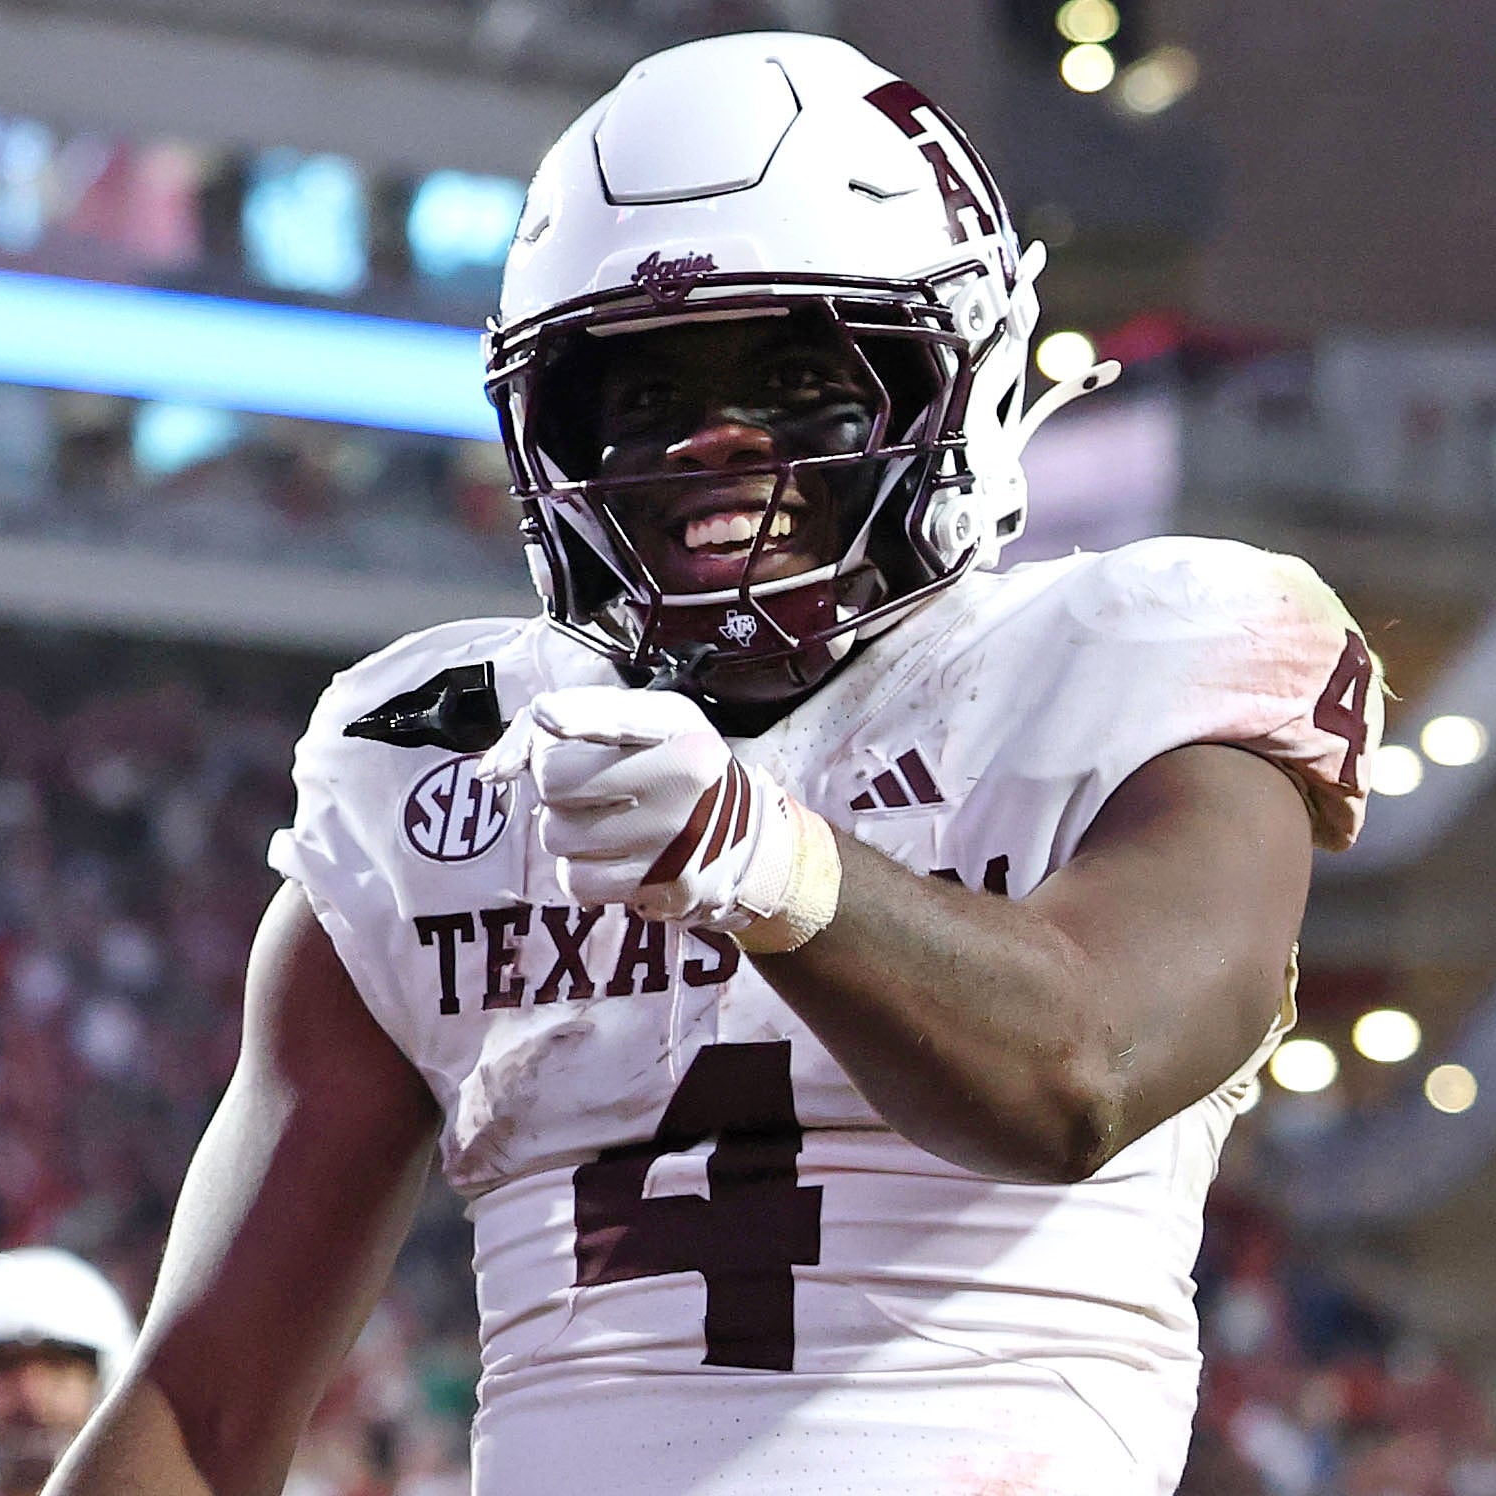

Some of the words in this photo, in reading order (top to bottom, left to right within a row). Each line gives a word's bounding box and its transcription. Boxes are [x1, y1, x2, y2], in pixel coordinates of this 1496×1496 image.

[1313, 628, 1373, 791] 4
[411, 760, 509, 857] SEC
[413, 899, 742, 1016] TEXAS
[573, 1040, 824, 1371] 4
